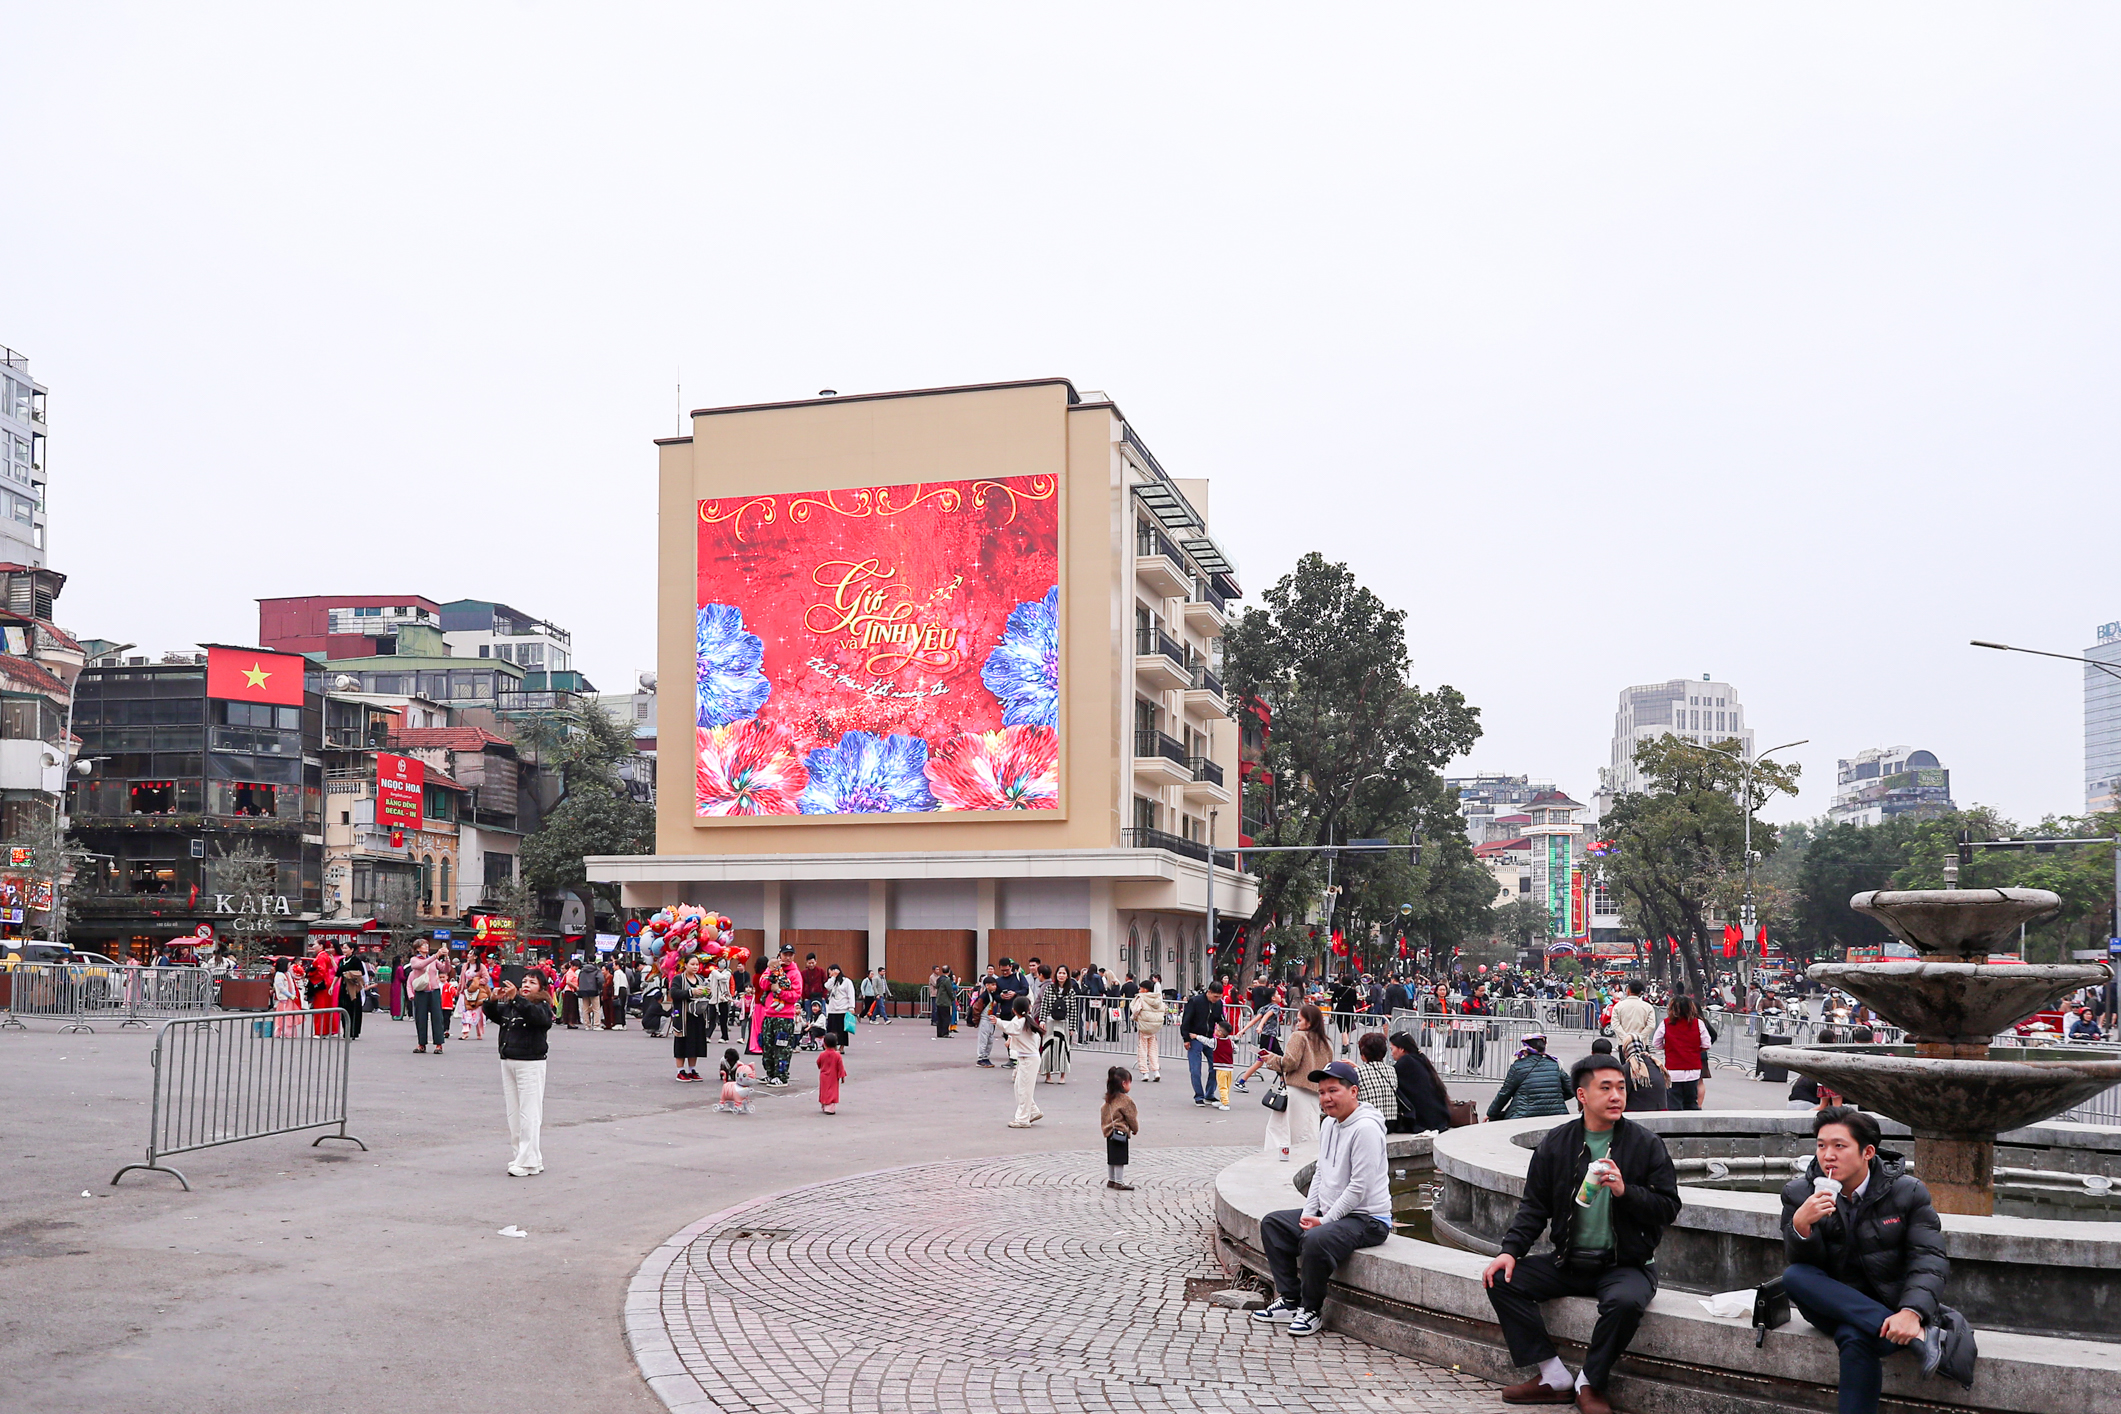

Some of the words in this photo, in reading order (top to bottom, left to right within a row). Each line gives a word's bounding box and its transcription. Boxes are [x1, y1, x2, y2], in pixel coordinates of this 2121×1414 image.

[805, 559, 911, 633] Gió
[840, 637, 858, 649] và
[381, 778, 403, 791] NGỌC
[405, 782, 421, 794] HOA
[214, 894, 291, 915] KAFA
